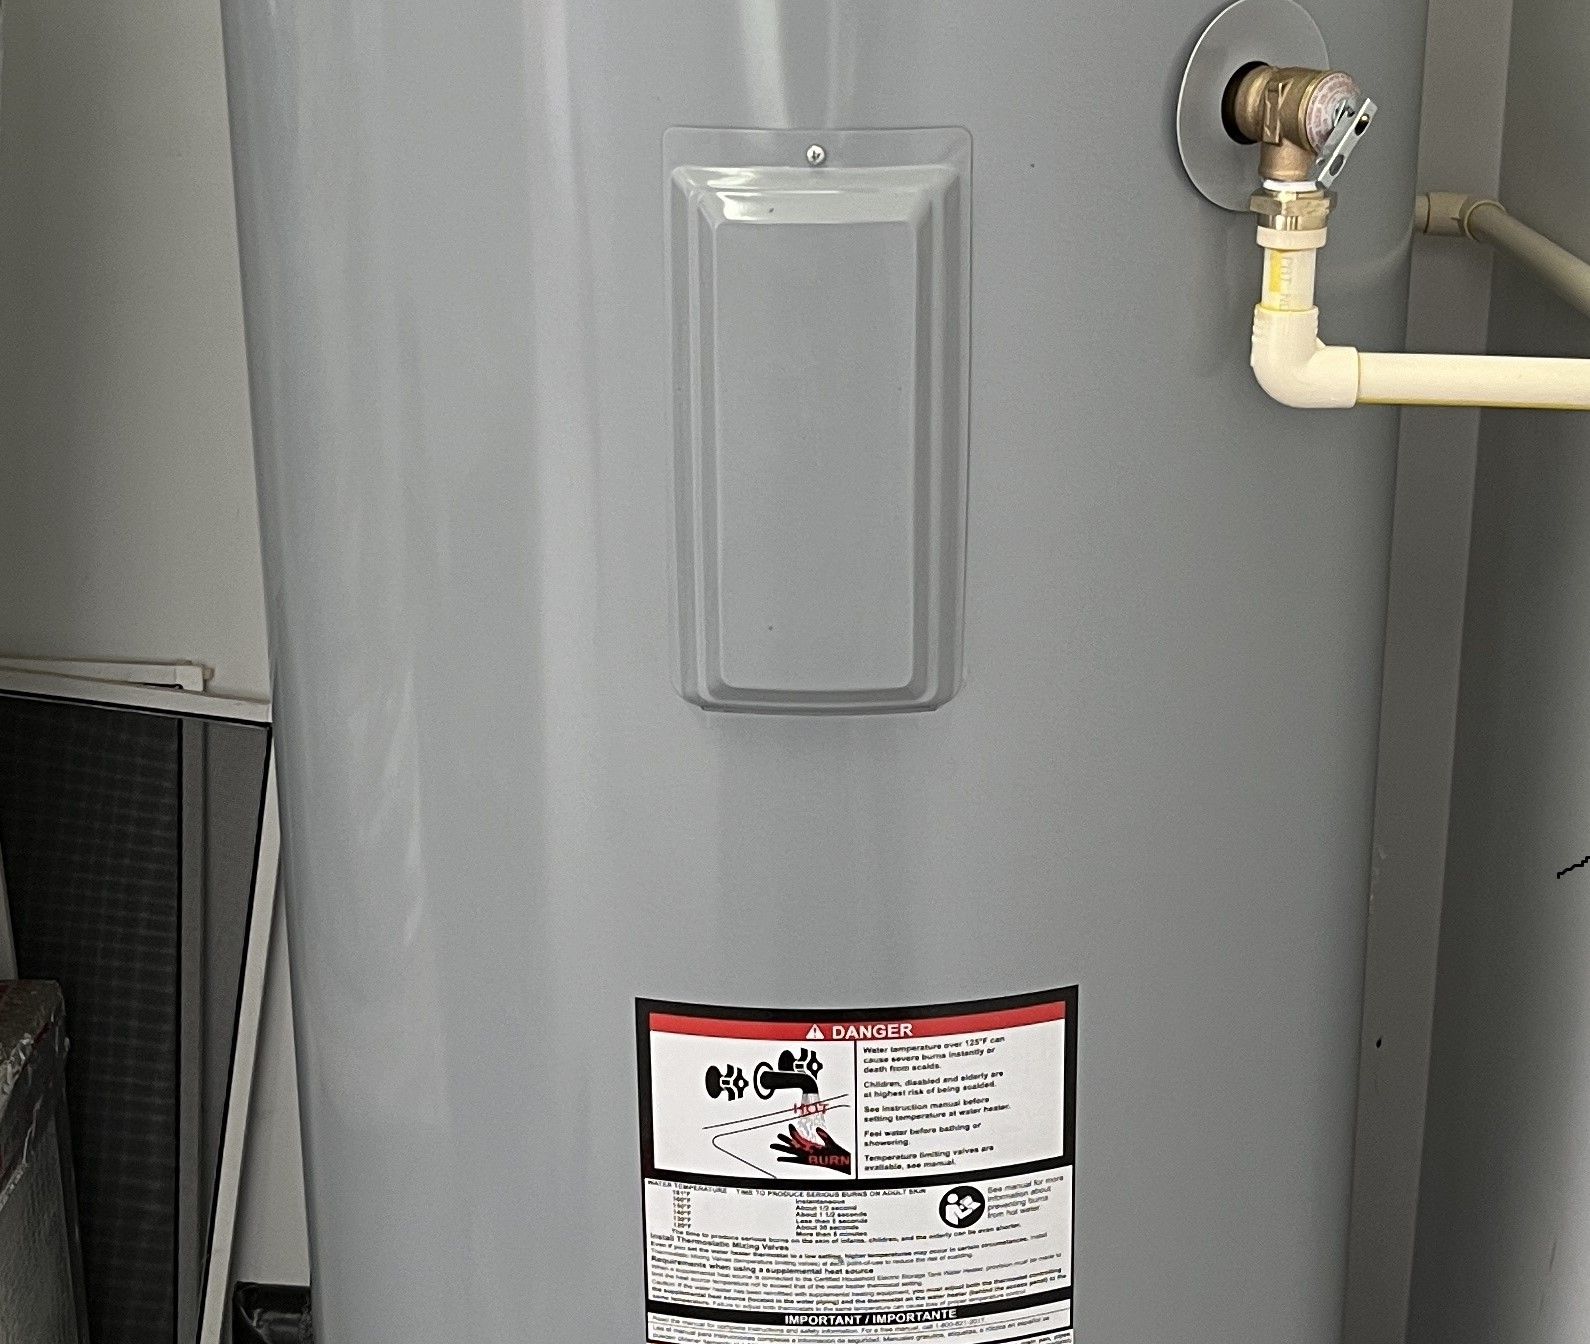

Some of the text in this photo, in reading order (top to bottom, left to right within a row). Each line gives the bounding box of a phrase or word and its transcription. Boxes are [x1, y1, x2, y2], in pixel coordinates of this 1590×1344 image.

[832, 1024, 913, 1039] DANGER
[891, 1043, 941, 1053] temperature
[949, 1049, 984, 1058] instantly
[905, 1077, 940, 1086] disabled
[961, 1072, 988, 1082] elderly
[874, 1089, 905, 1098] highest
[908, 1088, 923, 1096] risk
[937, 1085, 960, 1094] being
[794, 1103, 829, 1114] HOT
[882, 1103, 927, 1112] instruction
[930, 1100, 960, 1109] manual
[963, 1097, 989, 1105] before
[864, 1114, 893, 1123] setting
[896, 1112, 946, 1122] temperature
[939, 1124, 969, 1132] bathing
[809, 1156, 849, 1165] BURN
[865, 1153, 917, 1162] Temperature
[920, 1151, 950, 1159] limiting
[785, 1315, 862, 1325] IMPORTANT
[865, 1315, 869, 1324] /
[873, 1309, 957, 1324] IMPORTANTE
